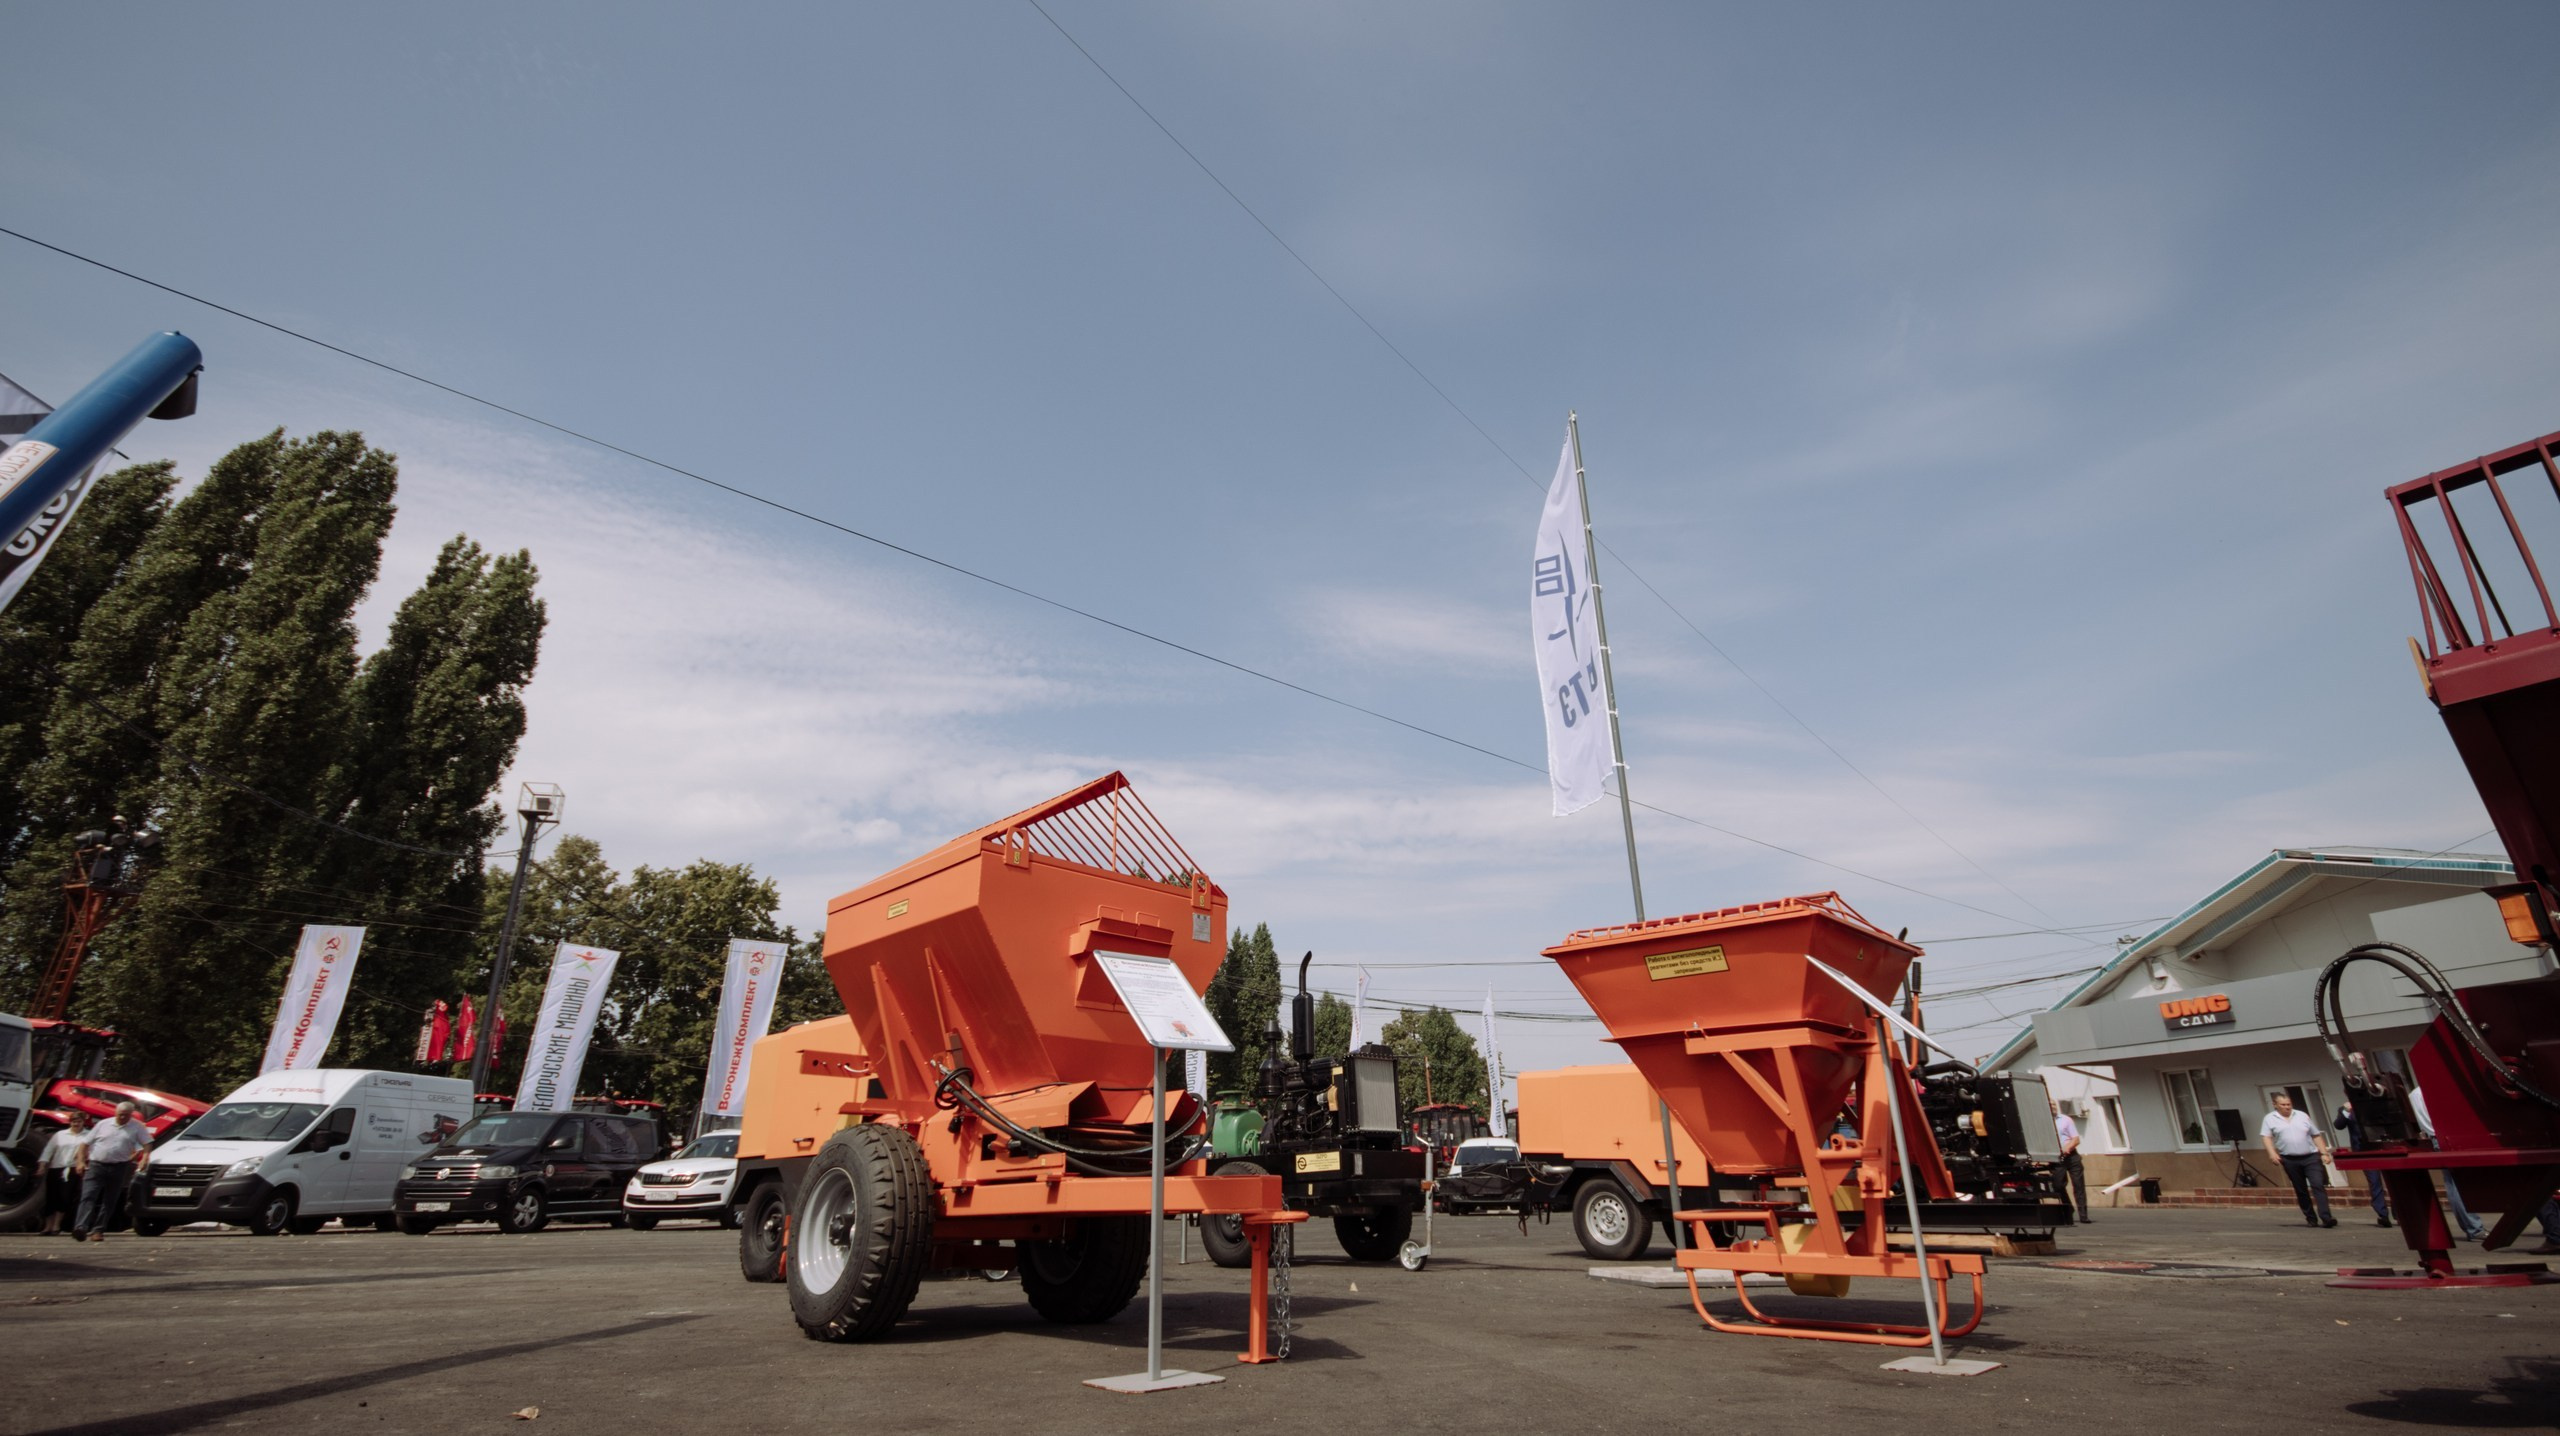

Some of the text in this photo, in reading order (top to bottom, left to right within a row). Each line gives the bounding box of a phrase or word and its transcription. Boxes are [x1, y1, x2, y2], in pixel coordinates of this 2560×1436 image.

[16, 442, 46, 457] НЕ
[1649, 963, 1679, 971] реагентами
[1690, 957, 1712, 966] средств
[1673, 966, 1703, 975] запрещена
[554, 977, 592, 1030] МАШИНЫ
[2159, 993, 2231, 1019] UMG
[284, 968, 331, 1070] НЕЖКОМПЛЕКТ
[2180, 1013, 2217, 1027] СДМ
[427, 1094, 457, 1103] СЕРВИС
